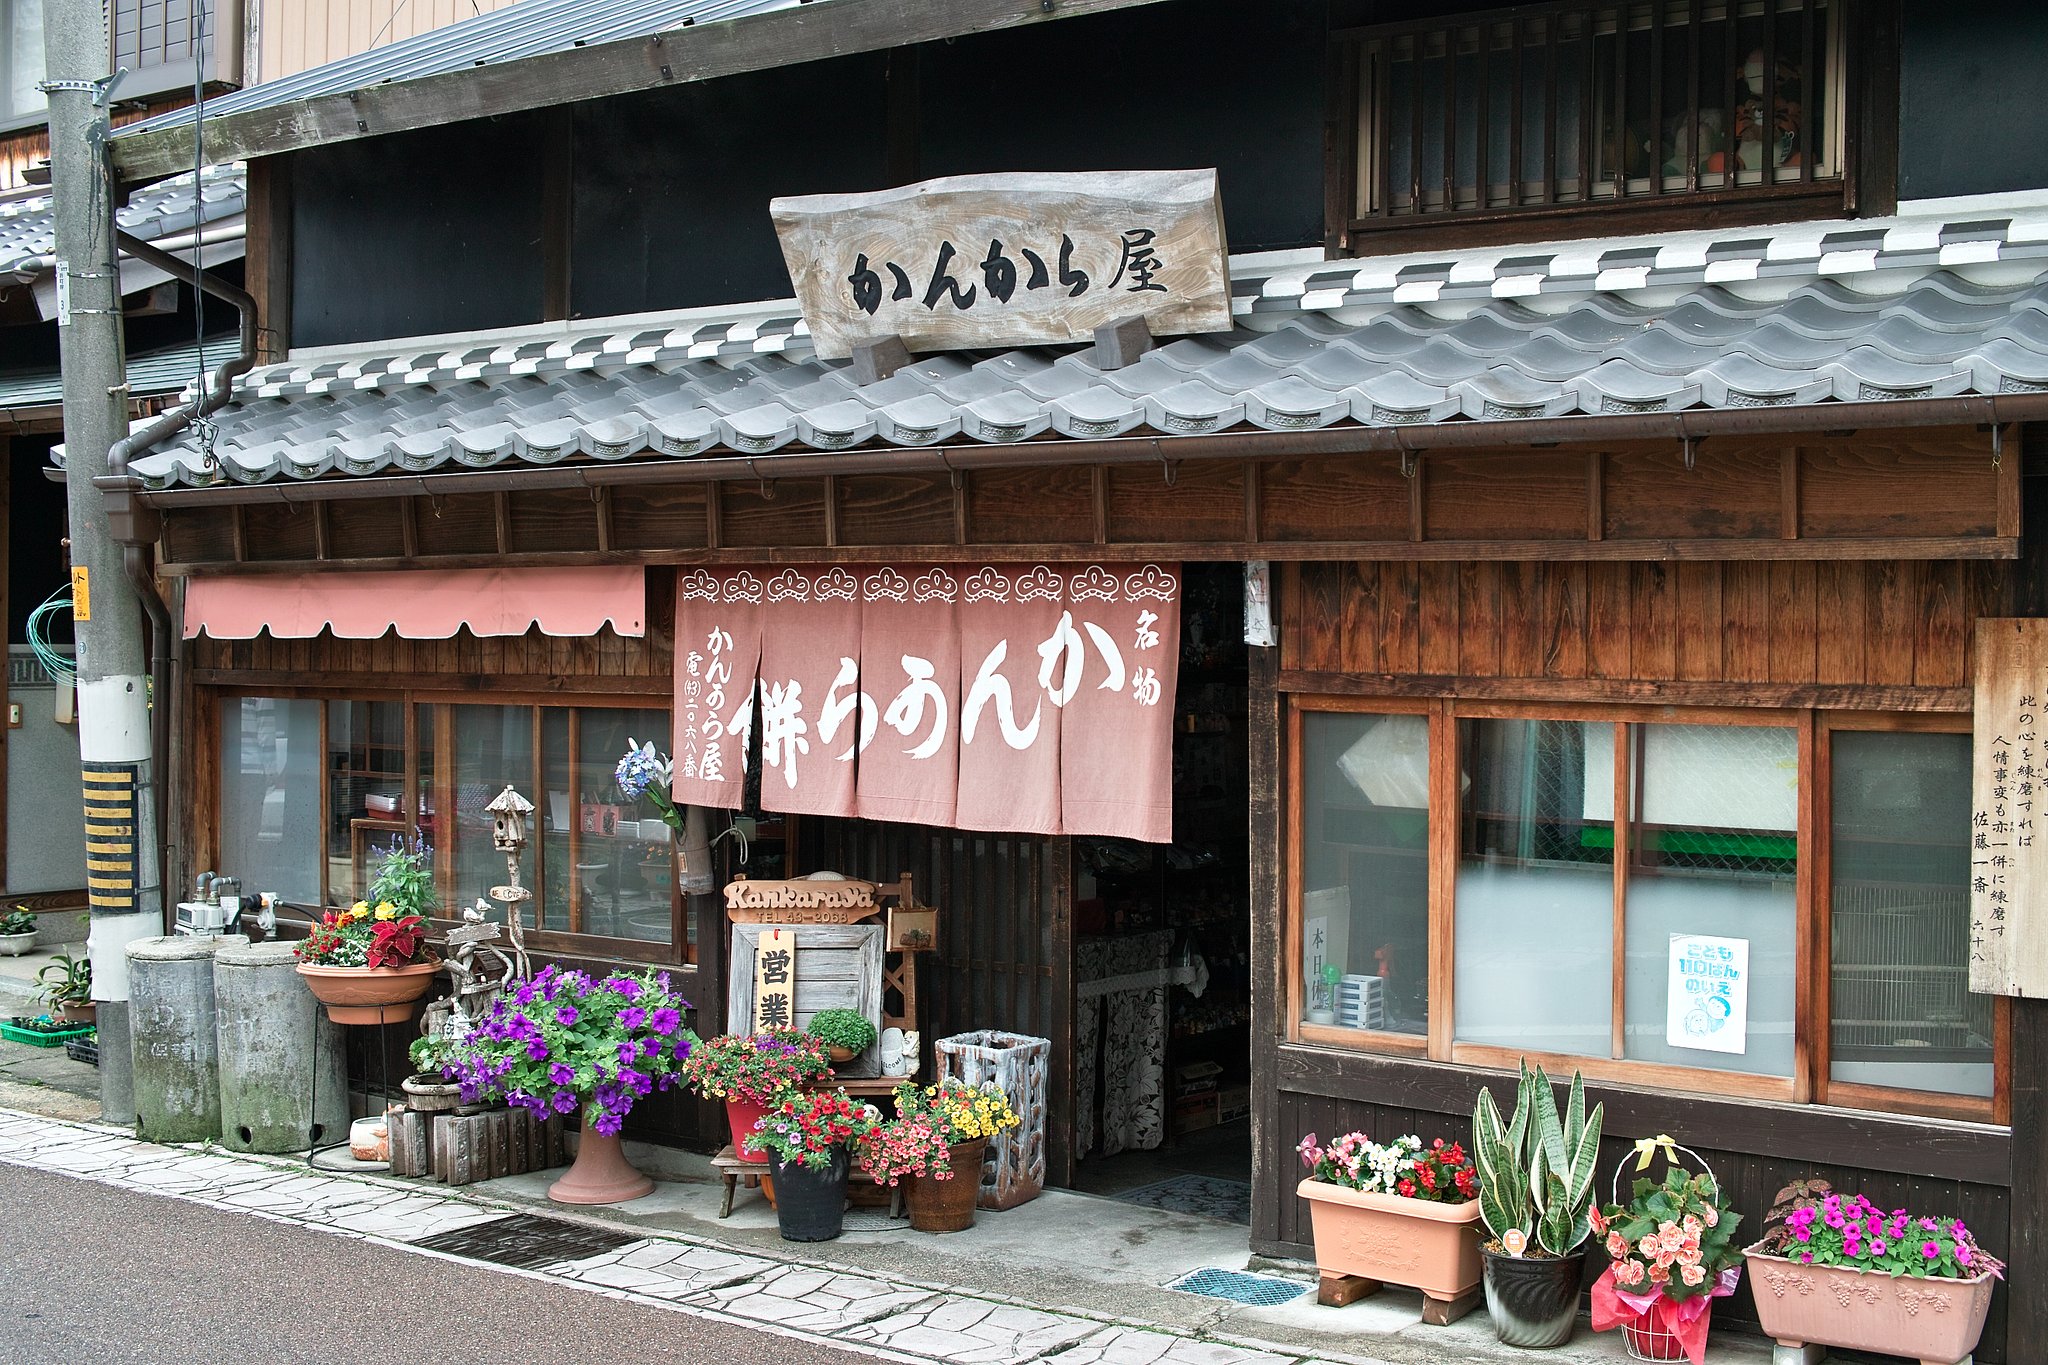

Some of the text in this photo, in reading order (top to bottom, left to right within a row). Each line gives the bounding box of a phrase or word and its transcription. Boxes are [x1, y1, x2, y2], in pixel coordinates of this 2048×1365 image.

[1132, 609, 1161, 706] 名物
[757, 912, 782, 924] TEL
[1687, 943, 1734, 962] こども
[1685, 978, 1733, 998] のいえ
